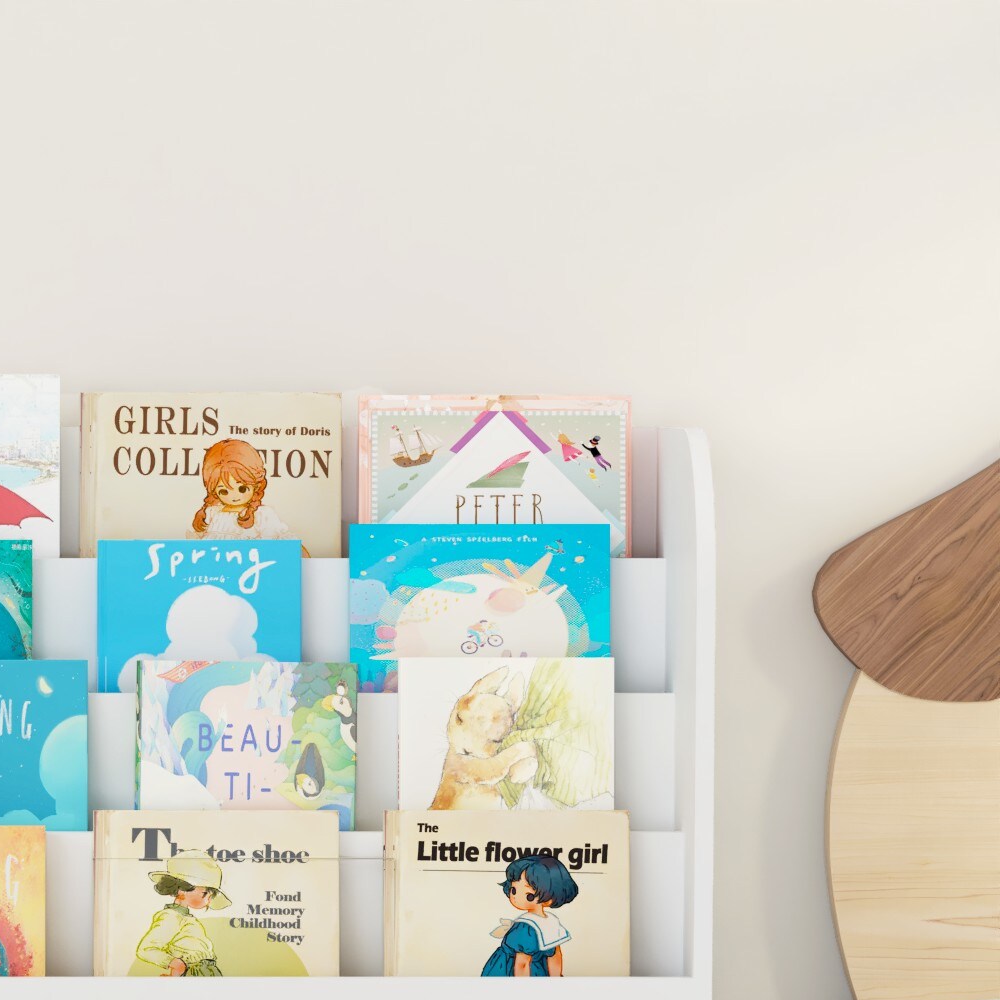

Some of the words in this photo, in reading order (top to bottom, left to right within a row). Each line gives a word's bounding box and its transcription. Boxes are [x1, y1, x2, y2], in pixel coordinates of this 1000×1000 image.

[114, 405, 219, 435] GIRLS
[229, 425, 249, 435] The
[253, 426, 281, 437] story
[285, 427, 297, 436] of
[300, 427, 331, 436] Doris
[113, 446, 332, 478] COLLION
[143, 543, 277, 594] Spring
[198, 723, 302, 753] BEAU-
[417, 823, 439, 833] The
[206, 845, 245, 863] toe
[251, 844, 310, 863] shoe
[417, 841, 479, 862] Little
[568, 844, 609, 870] girl
[265, 891, 302, 902] Fond
[246, 904, 305, 918] Memory
[229, 917, 301, 929] Childhood
[266, 932, 305, 945] Story
